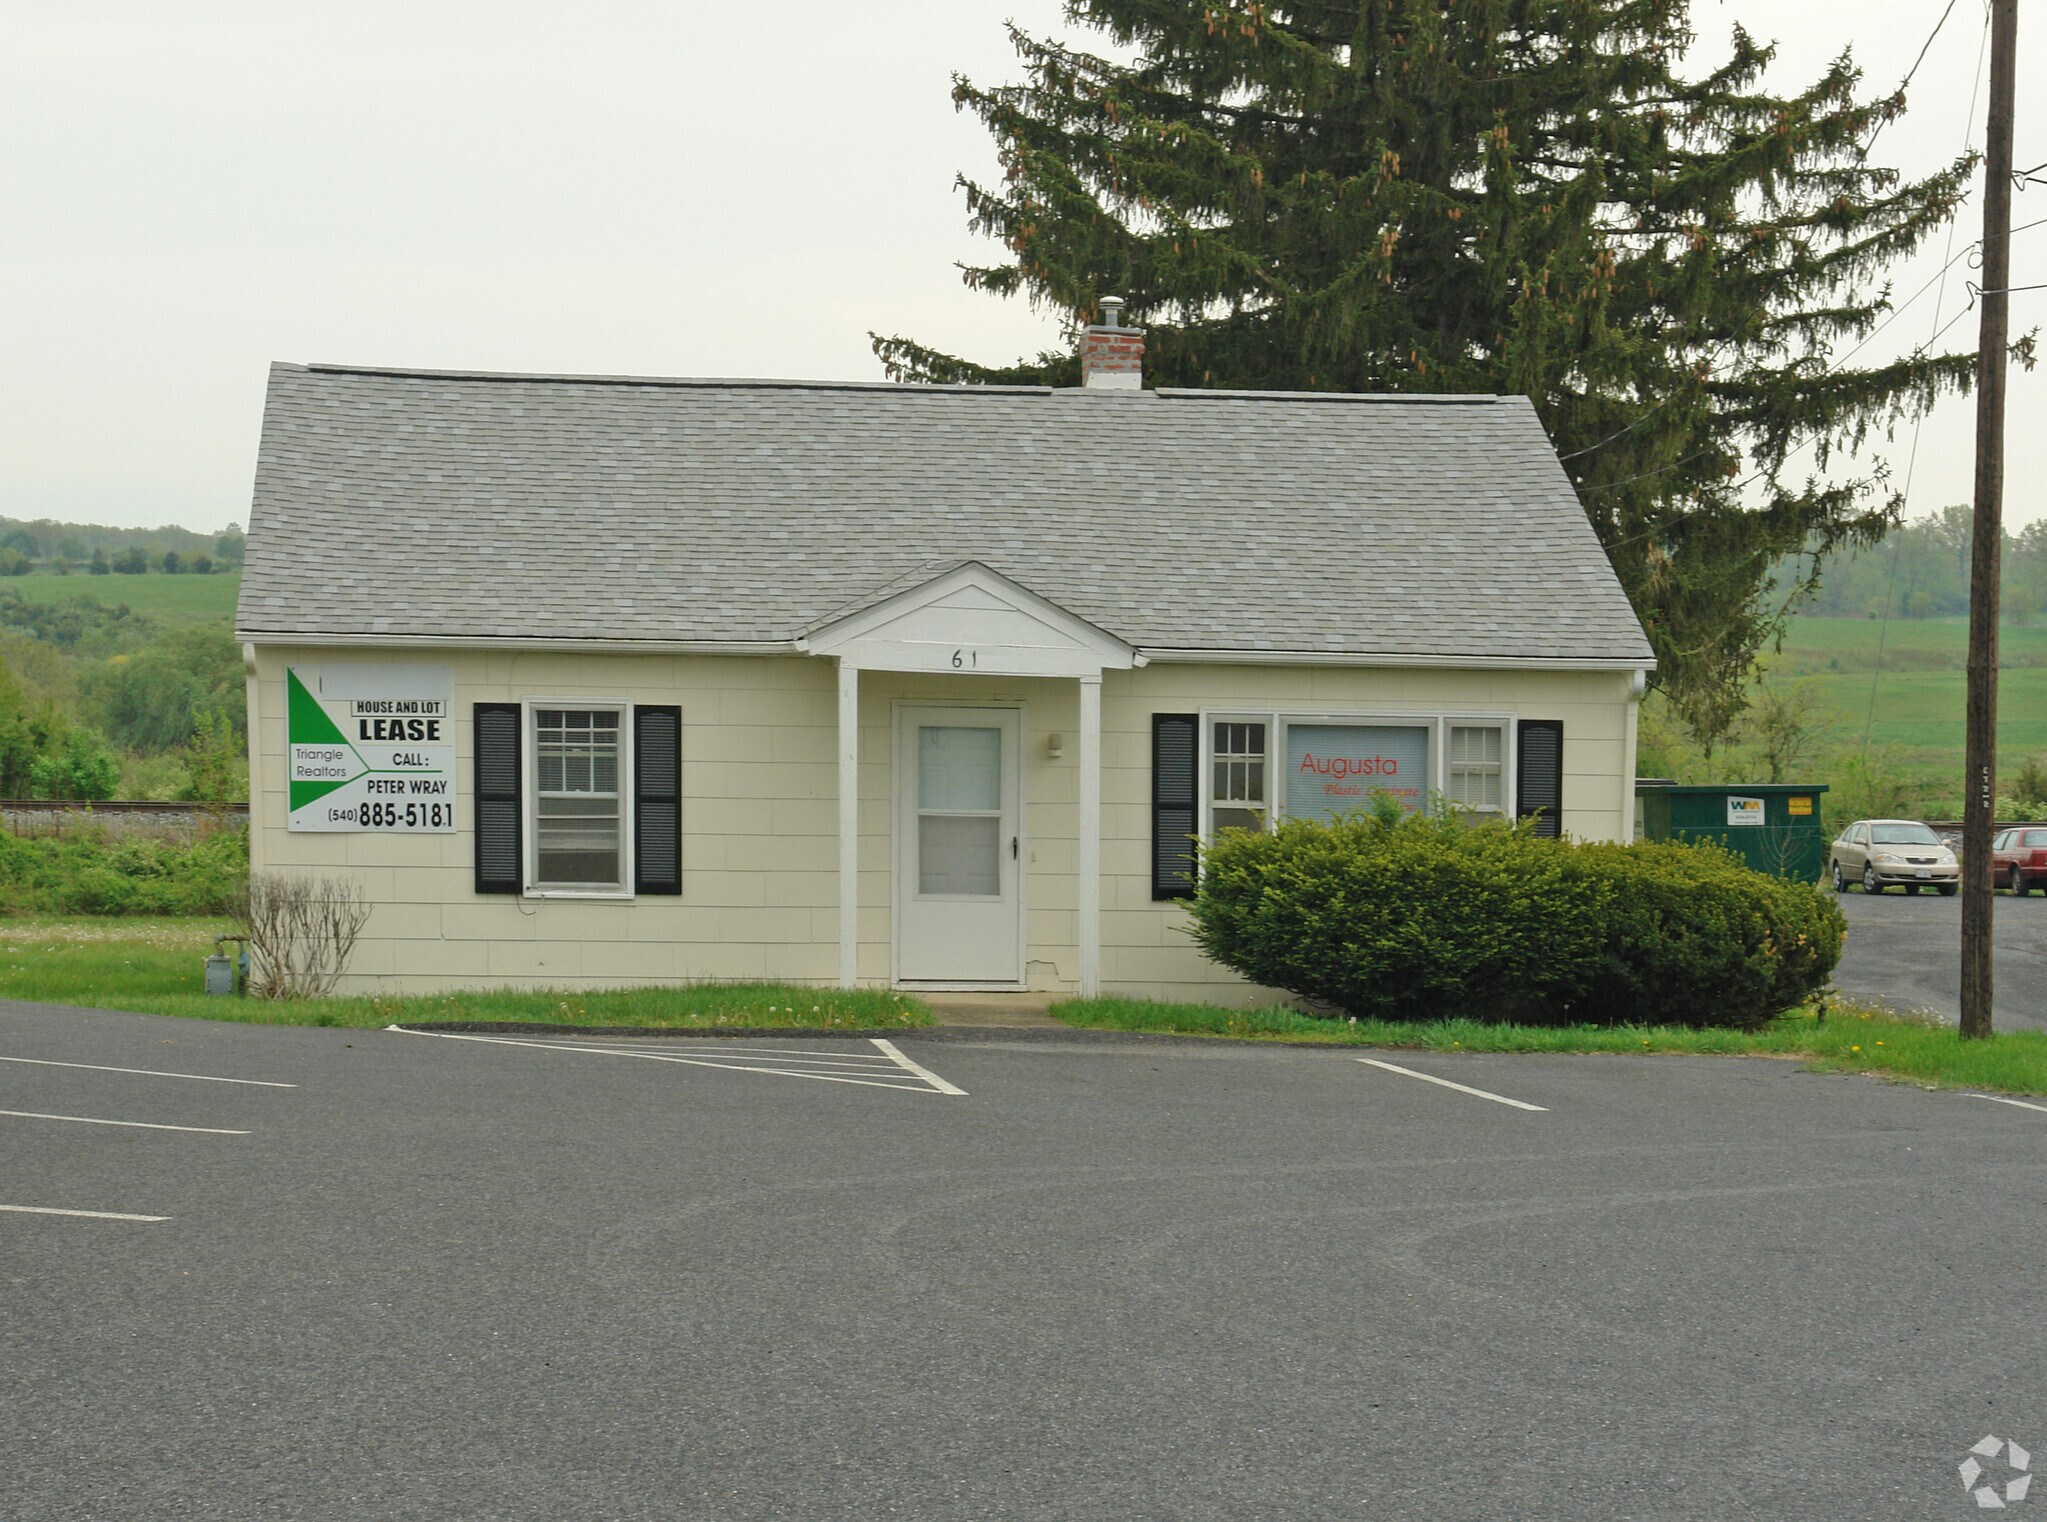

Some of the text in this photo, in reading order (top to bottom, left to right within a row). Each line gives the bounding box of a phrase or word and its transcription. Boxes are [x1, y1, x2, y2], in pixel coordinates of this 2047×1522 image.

[952, 649, 976, 668] 61
[357, 701, 440, 713] HOUSE AND LOT
[360, 719, 440, 741] LEASE
[296, 749, 343, 762] Triangle
[297, 766, 346, 777] Realtors
[1300, 753, 1397, 779] Augusta
[367, 780, 447, 794] PETER WRAY
[1731, 801, 1760, 810] WM
[328, 802, 452, 827] (540) 885-5181
